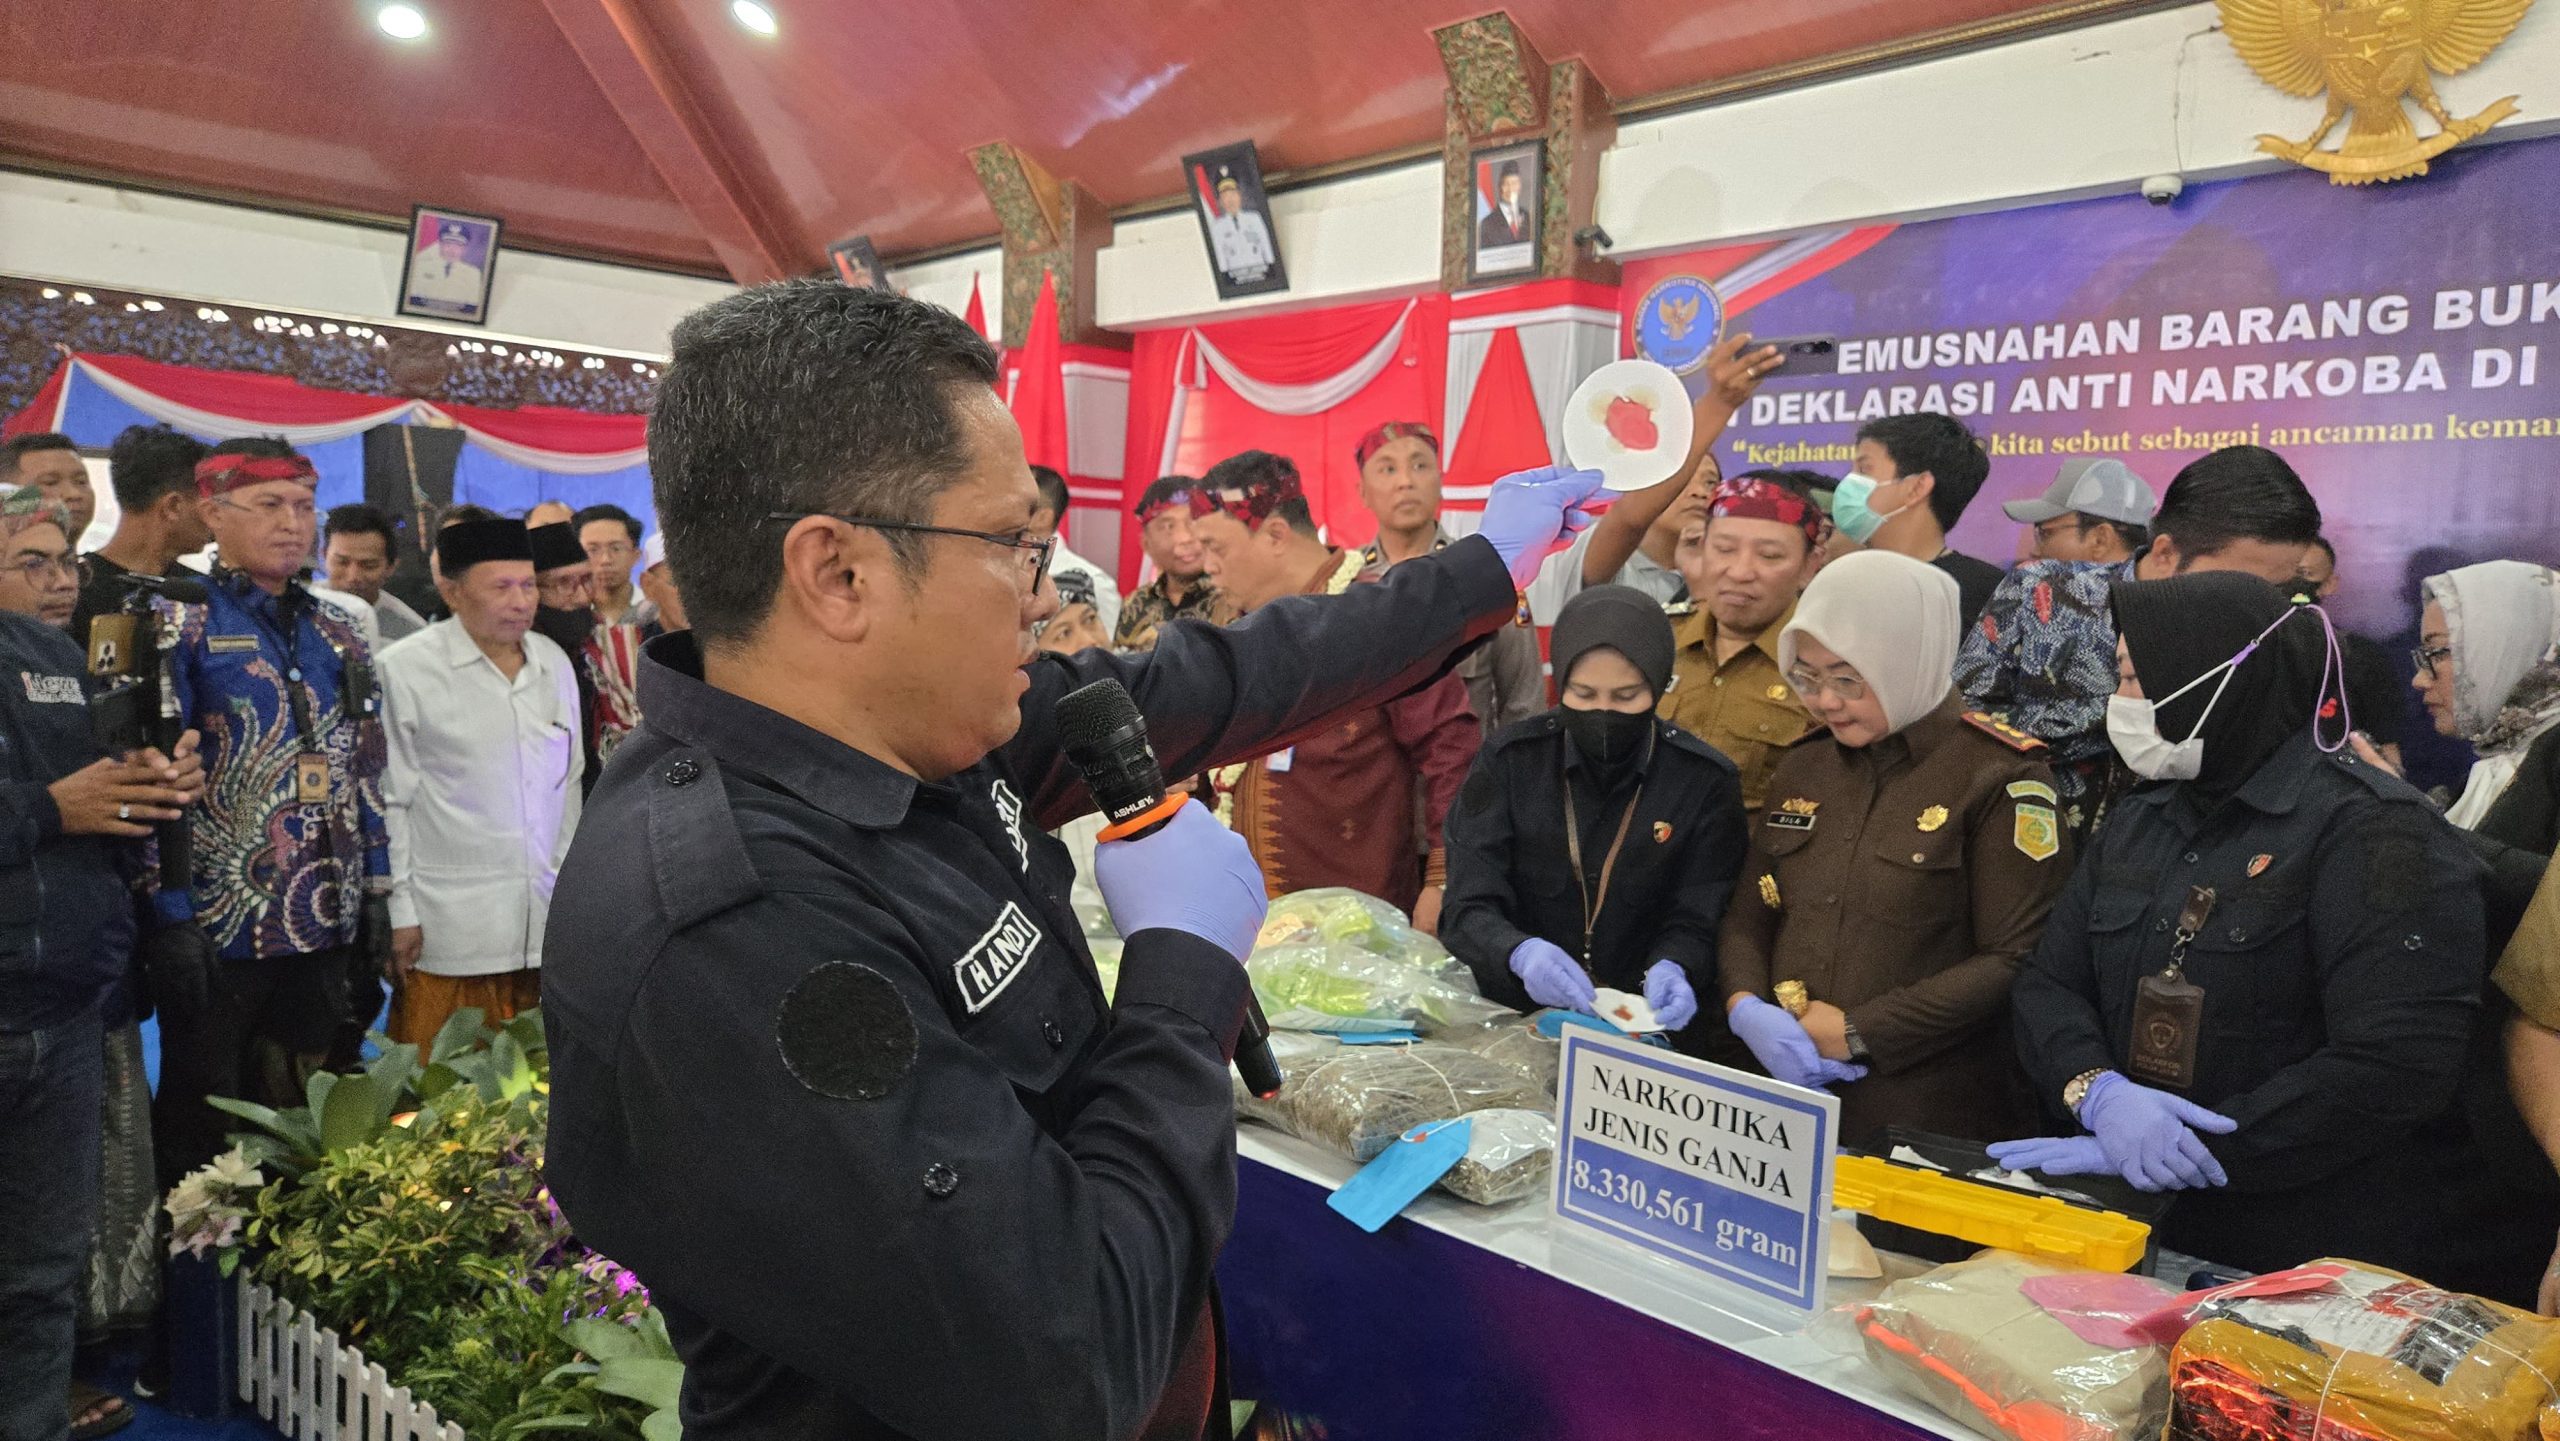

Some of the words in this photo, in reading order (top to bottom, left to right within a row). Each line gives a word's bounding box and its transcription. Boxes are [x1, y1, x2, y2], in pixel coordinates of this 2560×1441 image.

[1837, 318, 2140, 374] EMUSNAHAN
[2160, 295, 2409, 350] BARANG
[1750, 380, 1996, 427] DEKLARASI
[2009, 372, 2132, 413] ANTI
[2151, 352, 2447, 406] NARKOBA
[2471, 346, 2537, 389] DI
[1990, 432, 2044, 456] kita
[2050, 428, 2131, 452] sebut
[2139, 423, 2260, 451] sebagai
[2269, 422, 2434, 446] ancaman
[968, 913, 1033, 995] HANDI
[1590, 1064, 1793, 1151] NARKOTIKA
[1584, 1105, 1668, 1156] JENIS
[1679, 1137, 1793, 1199] GANJA
[1573, 1159, 1705, 1234] 8.330,561
[1715, 1216, 1797, 1268] gram
